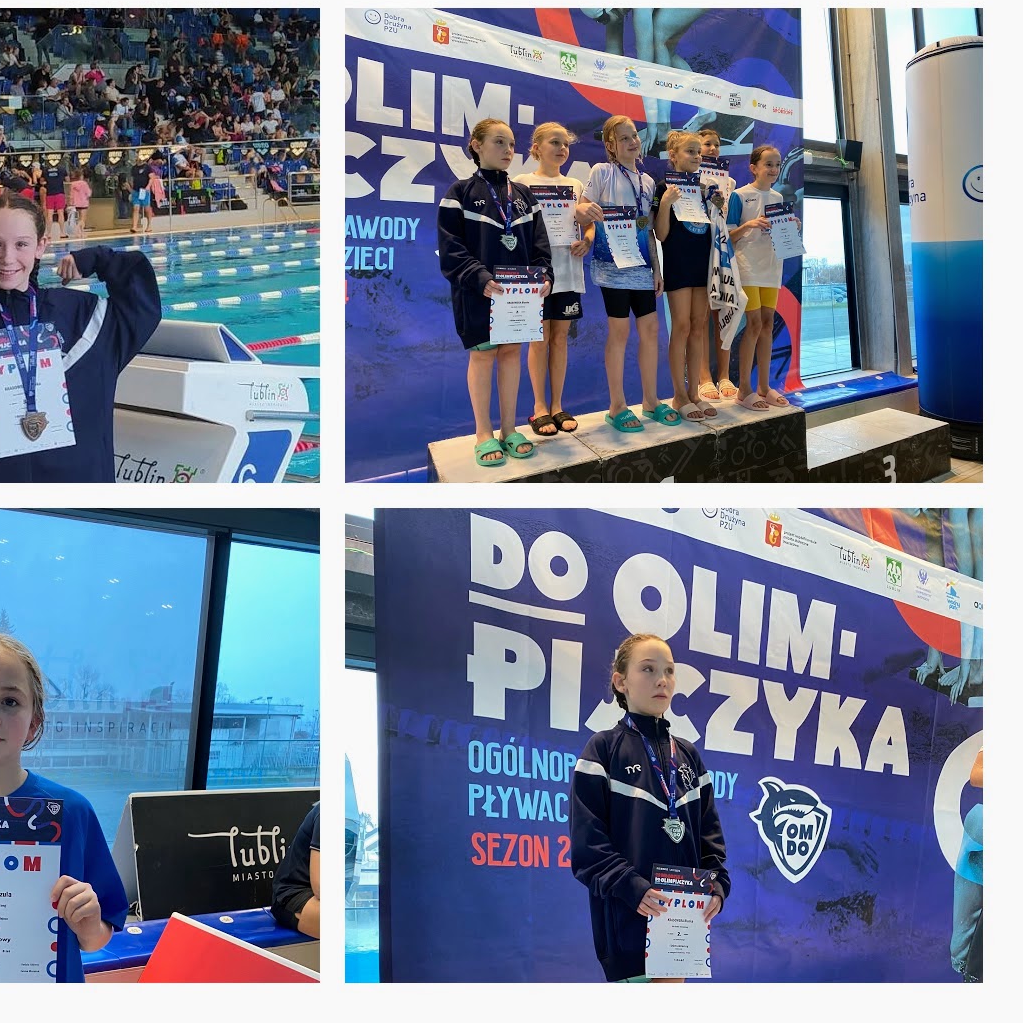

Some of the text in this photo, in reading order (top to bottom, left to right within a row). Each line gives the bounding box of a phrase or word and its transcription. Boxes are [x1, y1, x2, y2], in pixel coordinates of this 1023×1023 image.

[383, 12, 405, 23] Dobra
[383, 19, 412, 31] Drużyna
[383, 25, 398, 34] PZU
[698, 169, 725, 177] DYPLOM
[473, 199, 486, 207] TYR
[882, 454, 897, 483] 3
[719, 514, 746, 528] Drużyna
[719, 521, 734, 531] PZU
[469, 511, 590, 602] DO
[467, 621, 911, 777] PICZYKA
[467, 738, 577, 782] OGÓLNOP
[624, 763, 642, 775] TYR
[467, 784, 570, 824] PŁYWAC
[786, 822, 813, 841] OM
[471, 832, 550, 869] SEZON
[786, 840, 810, 857] DO
[232, 870, 274, 882] MIASTO
